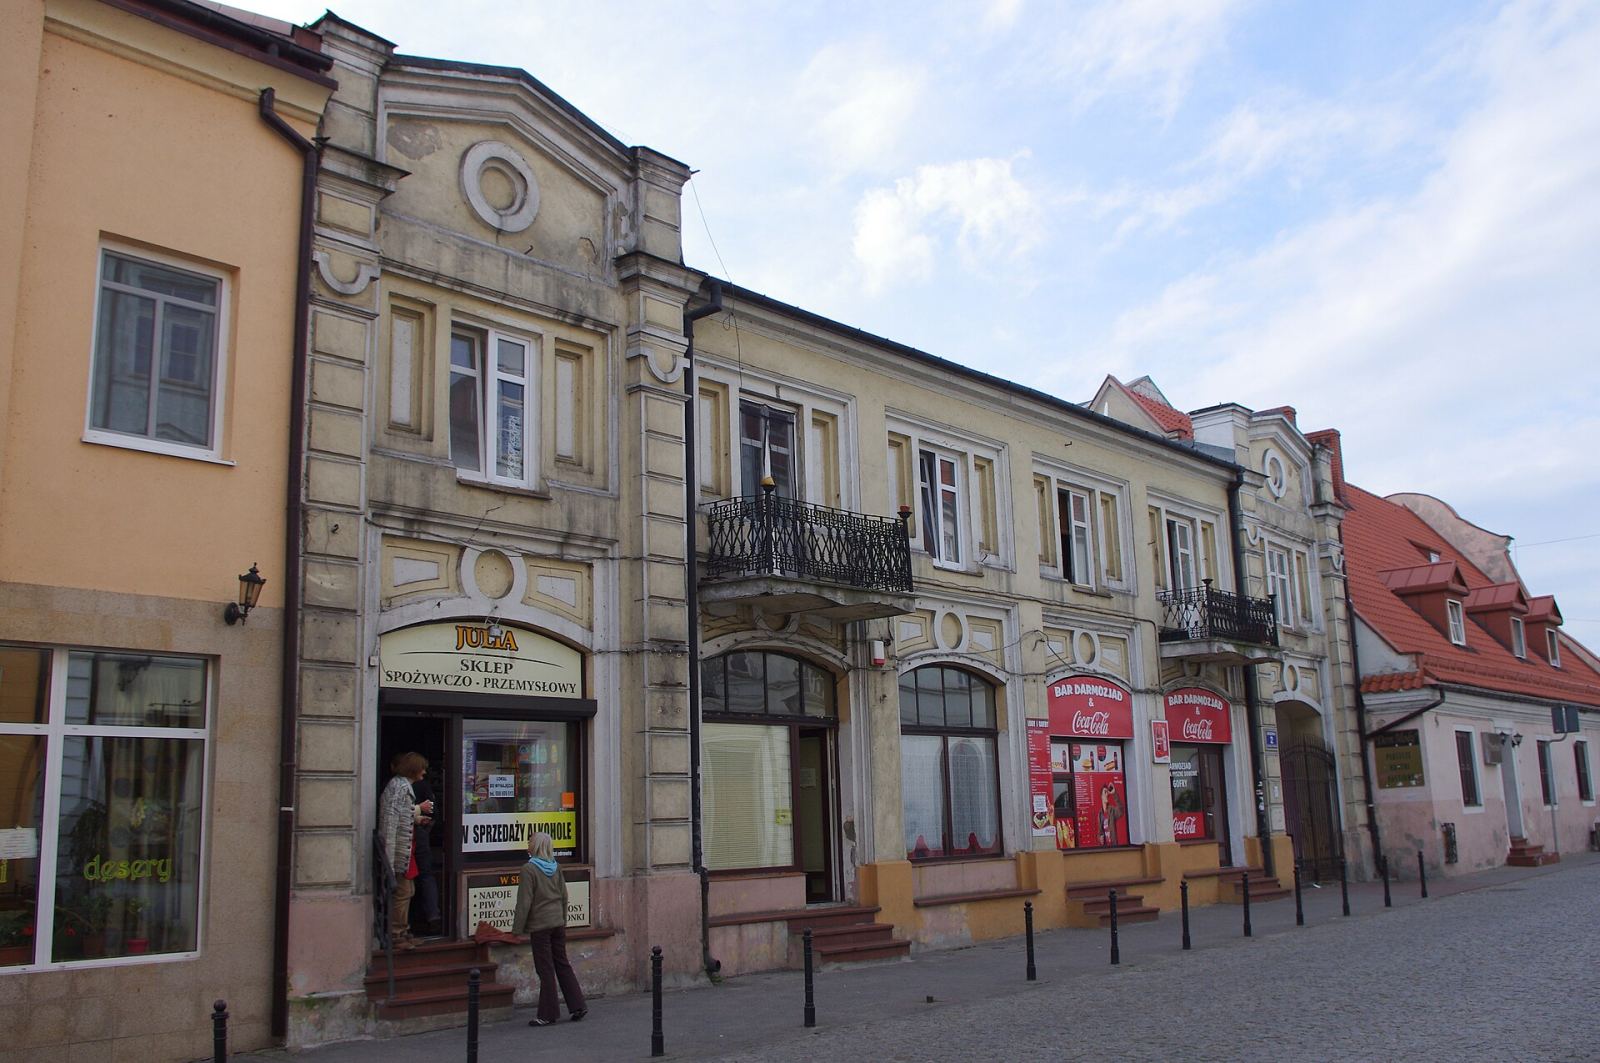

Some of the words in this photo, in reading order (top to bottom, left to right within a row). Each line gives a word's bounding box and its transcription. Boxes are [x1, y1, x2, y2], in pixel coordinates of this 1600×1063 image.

[460, 659, 513, 674] SKLEP
[385, 669, 472, 687] SPOŻYWCZO
[483, 677, 576, 694] PRZEMYSŁOWY
[1054, 684, 1073, 698] BAR
[1074, 683, 1123, 702] DARMOZJAD
[1088, 697, 1094, 707] &
[1168, 694, 1184, 706] BAR
[1184, 694, 1223, 710] DARMOZJAD
[473, 820, 525, 844] SPRZEDAŻY
[83, 854, 171, 883] desery
[479, 891, 511, 900] NAPOJE
